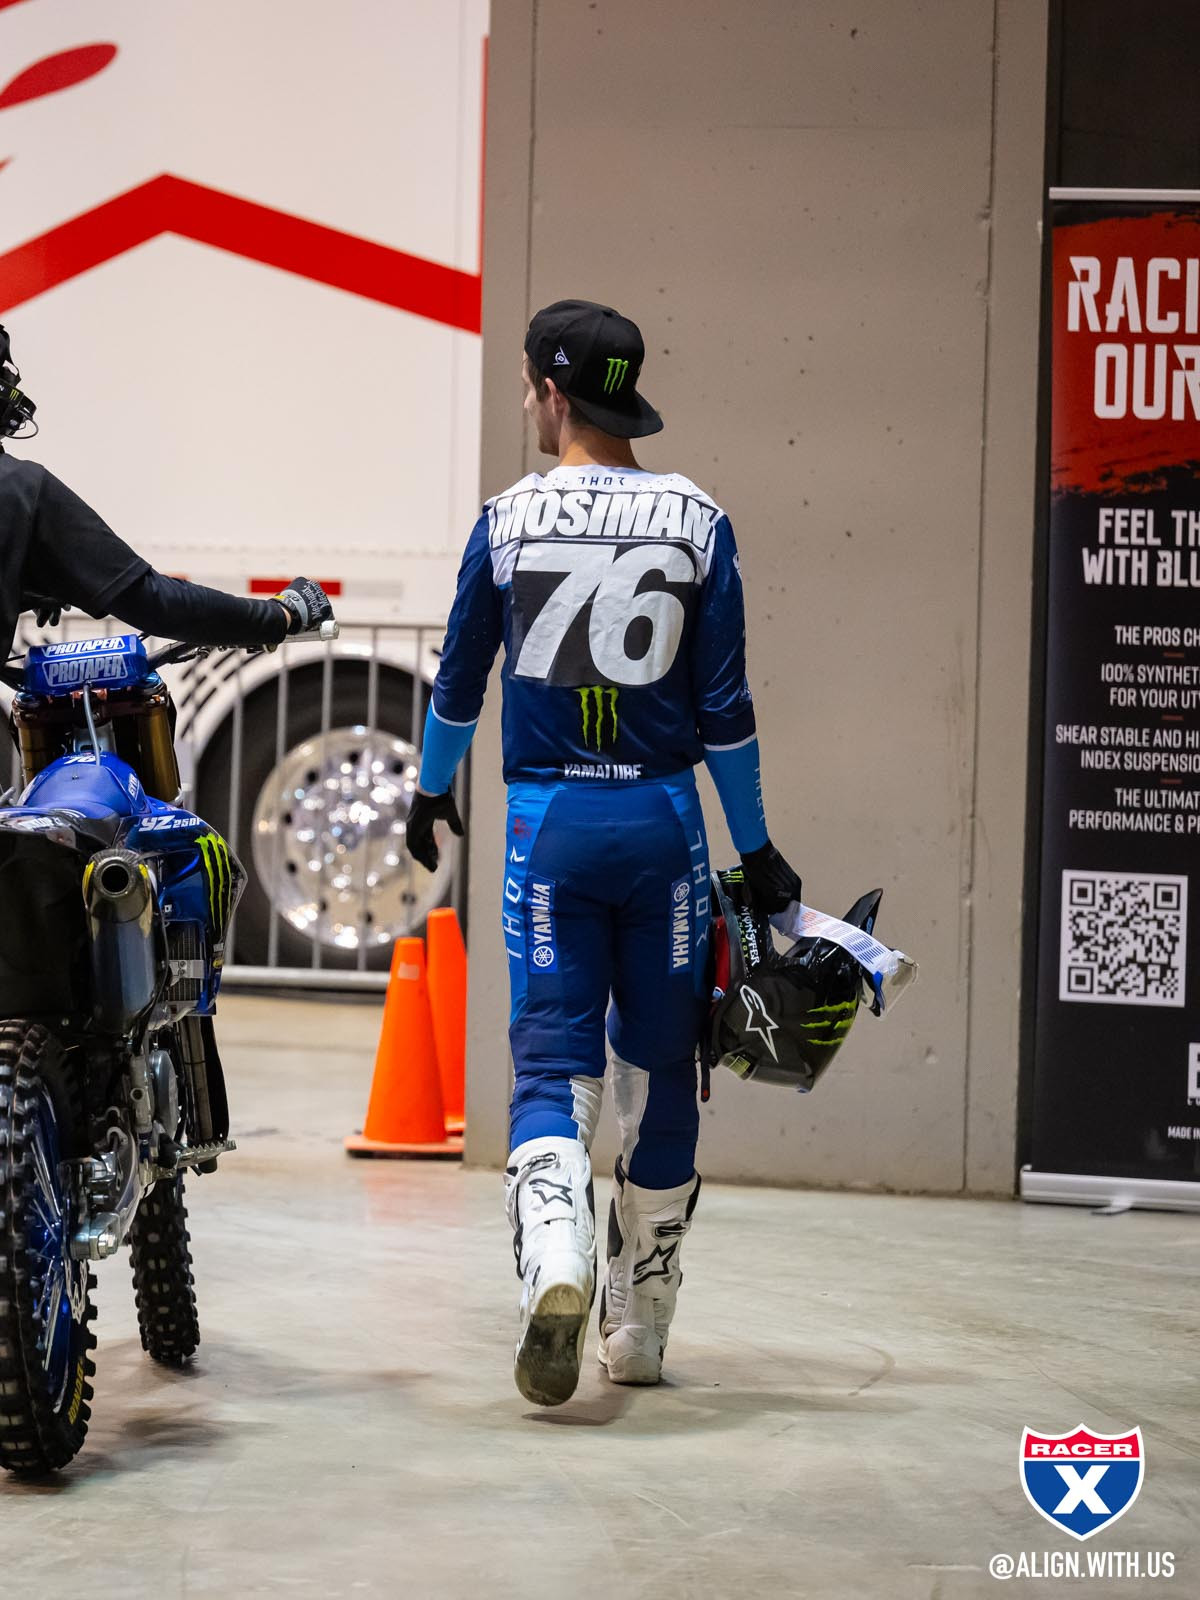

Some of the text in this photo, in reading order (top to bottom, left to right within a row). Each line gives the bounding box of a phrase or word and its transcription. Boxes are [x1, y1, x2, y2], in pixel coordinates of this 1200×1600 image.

[1067, 256, 1200, 334] RACI
[1093, 343, 1200, 421] OUR
[491, 491, 716, 550] MOSIMAN
[1098, 507, 1200, 546] FEEL TH
[1082, 547, 1148, 587] WITH
[514, 542, 696, 686] 76
[46, 637, 123, 656] PROTAPER
[1114, 625, 1200, 647] THE PROS CH
[48, 655, 121, 684] PROTAPER
[1101, 663, 1200, 685] 100% SYNTHET
[1110, 687, 1137, 707] FOR
[1139, 689, 1178, 709] YOUR
[1055, 724, 1200, 749] SHEAR STABLE AND HI
[1081, 750, 1200, 773] INDEX SUSPENSIO
[1114, 788, 1200, 810] THE ULTIMAT
[1069, 810, 1172, 833] PERFORMANCE
[1174, 814, 1184, 834] &
[673, 899, 690, 968] YAMAHA
[741, 905, 761, 966] MONSTER
[1168, 1125, 1192, 1139] MADE
